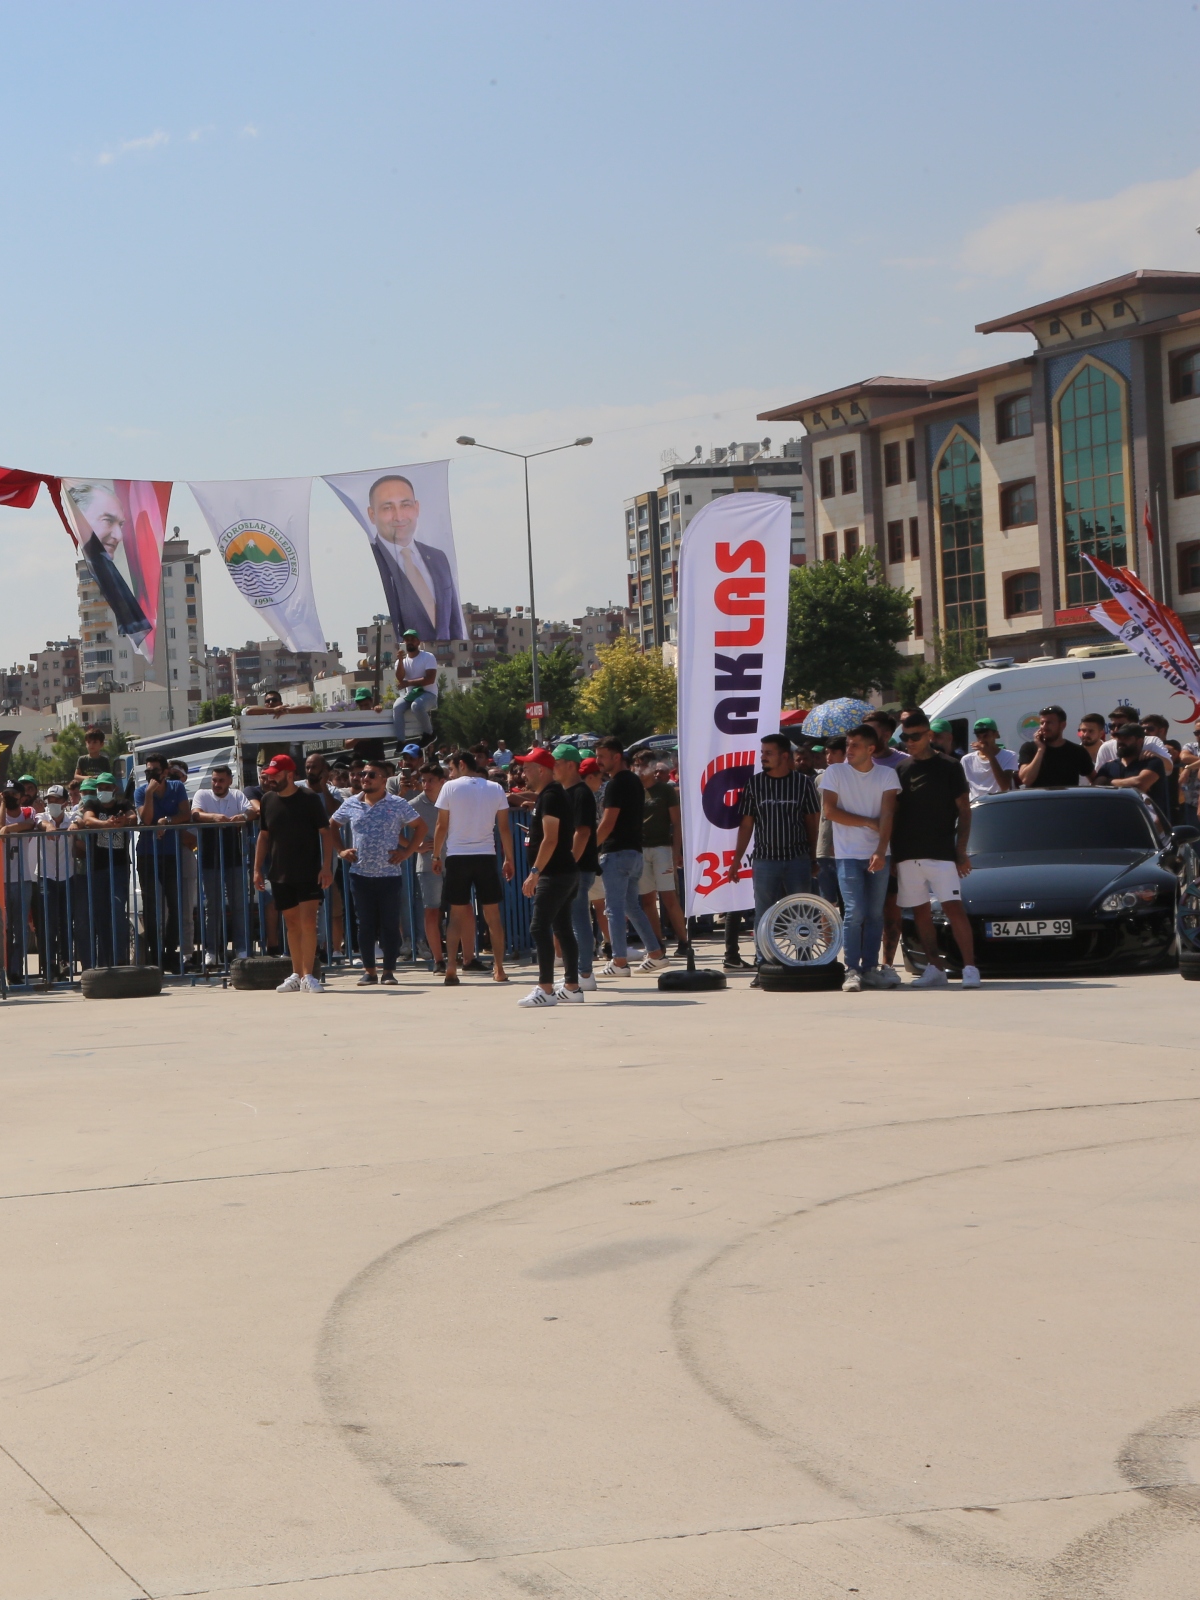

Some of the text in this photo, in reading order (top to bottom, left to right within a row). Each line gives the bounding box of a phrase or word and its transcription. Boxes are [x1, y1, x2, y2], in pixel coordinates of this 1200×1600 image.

[222, 522, 267, 543] TOROSLAR
[254, 597, 274, 606] 1994
[714, 540, 766, 735] AKLAS
[993, 922, 1010, 936] 34
[1014, 922, 1047, 936] ALP
[1052, 920, 1071, 934] 99
